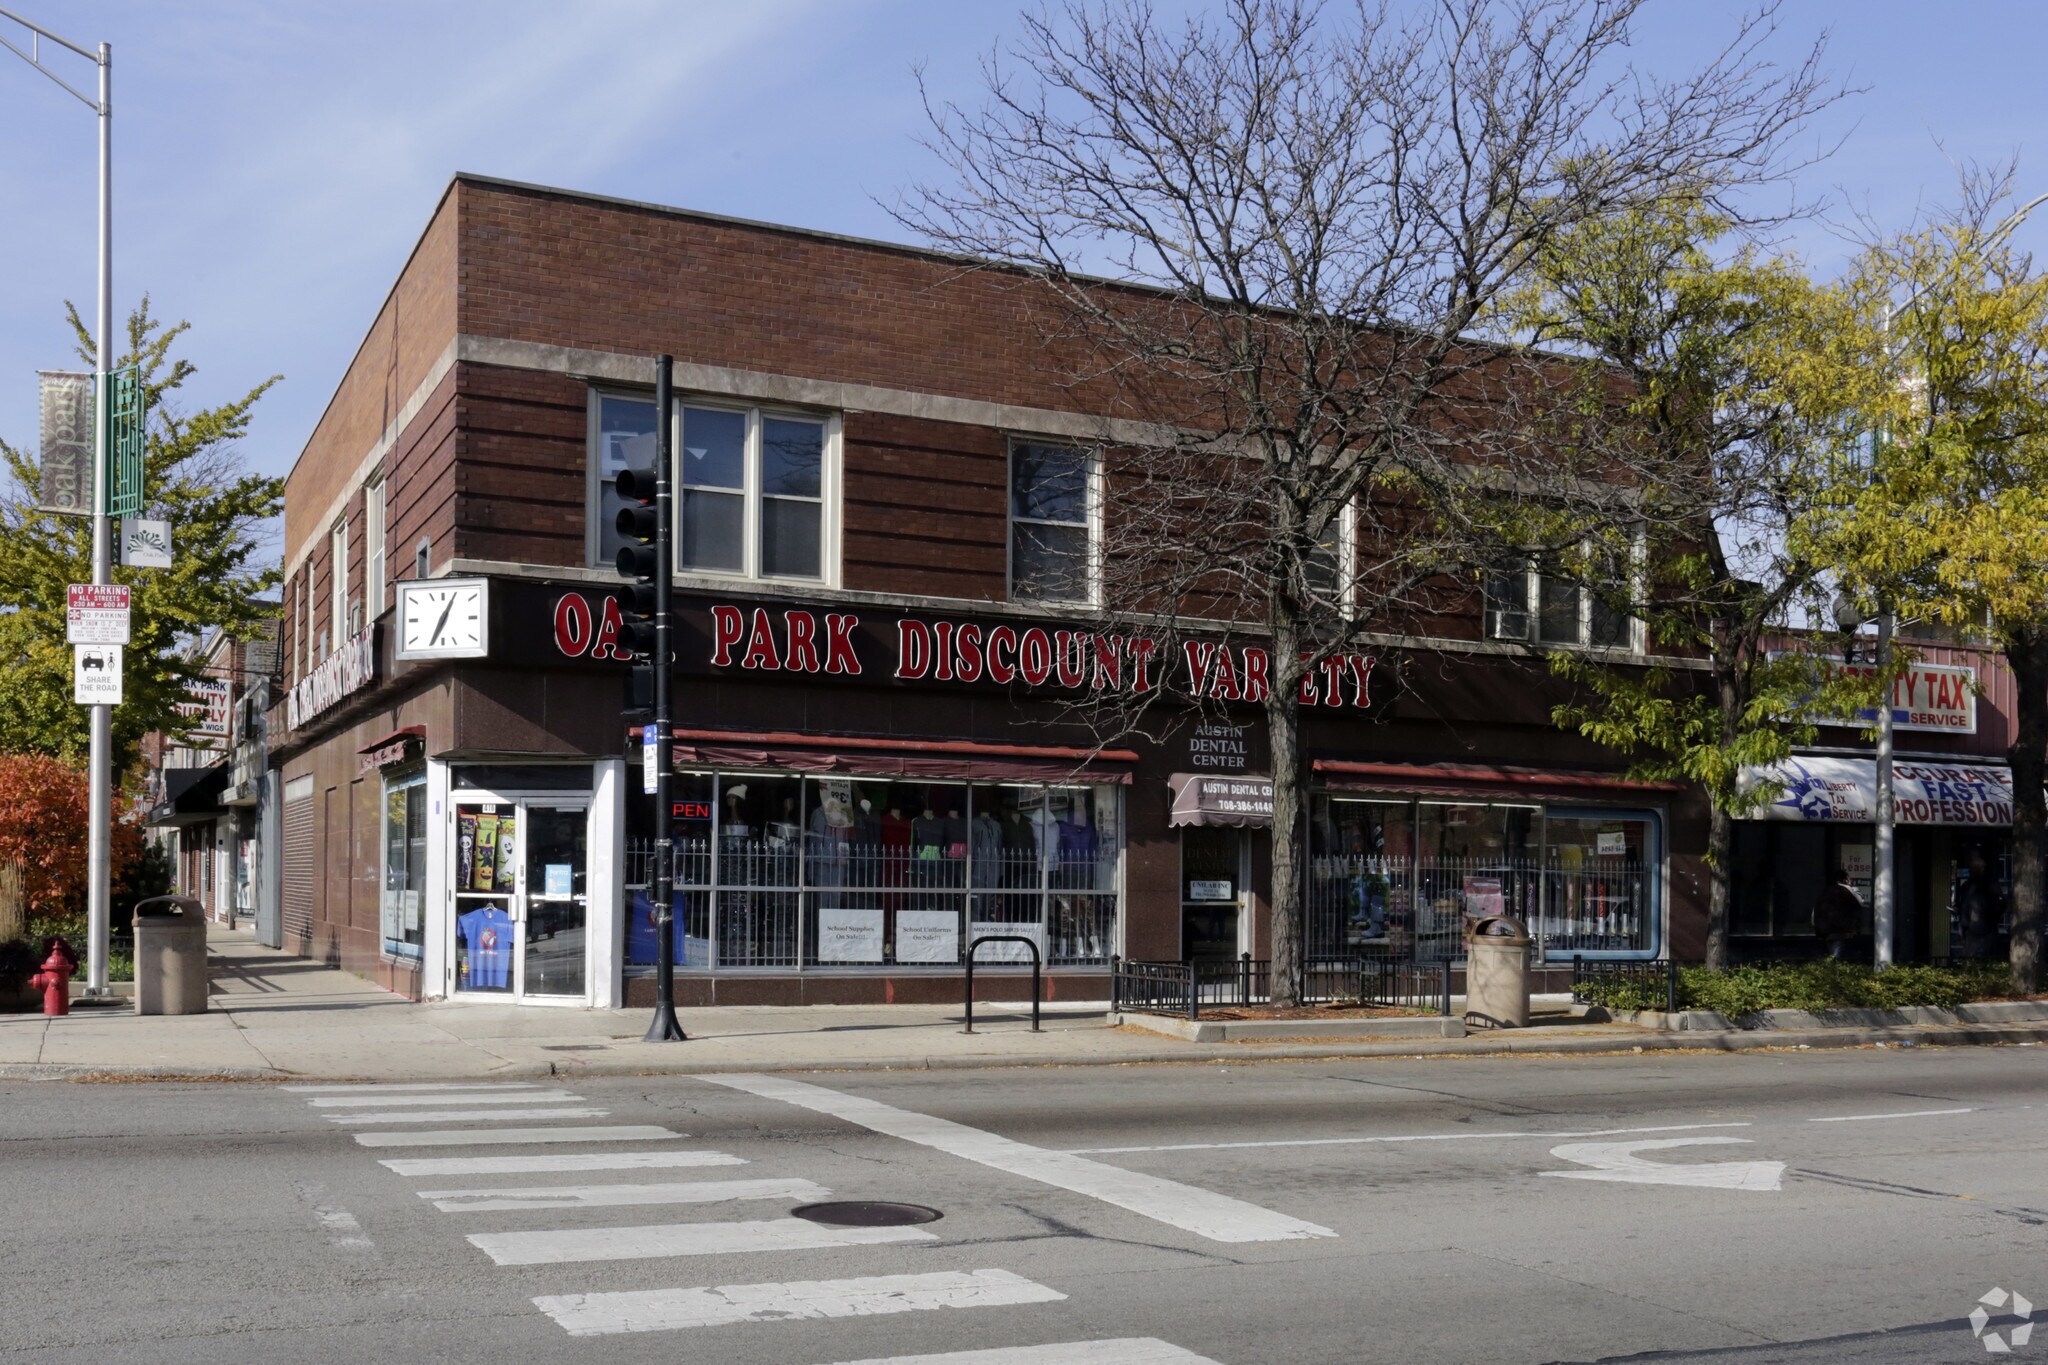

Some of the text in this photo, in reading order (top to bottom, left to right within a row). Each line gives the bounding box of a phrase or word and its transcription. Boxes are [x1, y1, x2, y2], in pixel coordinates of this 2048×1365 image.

[44, 379, 87, 447] park
[46, 453, 76, 509] oak
[71, 586, 127, 595] NO PARKING
[711, 605, 862, 675] PARK
[896, 619, 1155, 692] DISCOUNT
[1184, 640, 1376, 708] VARETY
[201, 681, 226, 691] PARK
[1924, 672, 1966, 710] TAX
[1910, 713, 1966, 726] SERVICE
[206, 724, 224, 732] WIGS
[1195, 725, 1242, 738] AUSTIN
[1189, 738, 1247, 754] DENTAL
[1192, 754, 1245, 767] CENTER
[1203, 783, 1228, 794] AUSTIN
[1231, 784, 1258, 795] DENTAL
[1921, 781, 1987, 801] FAST
[673, 803, 709, 817] PEN
[1841, 861, 1872, 871] Lease
